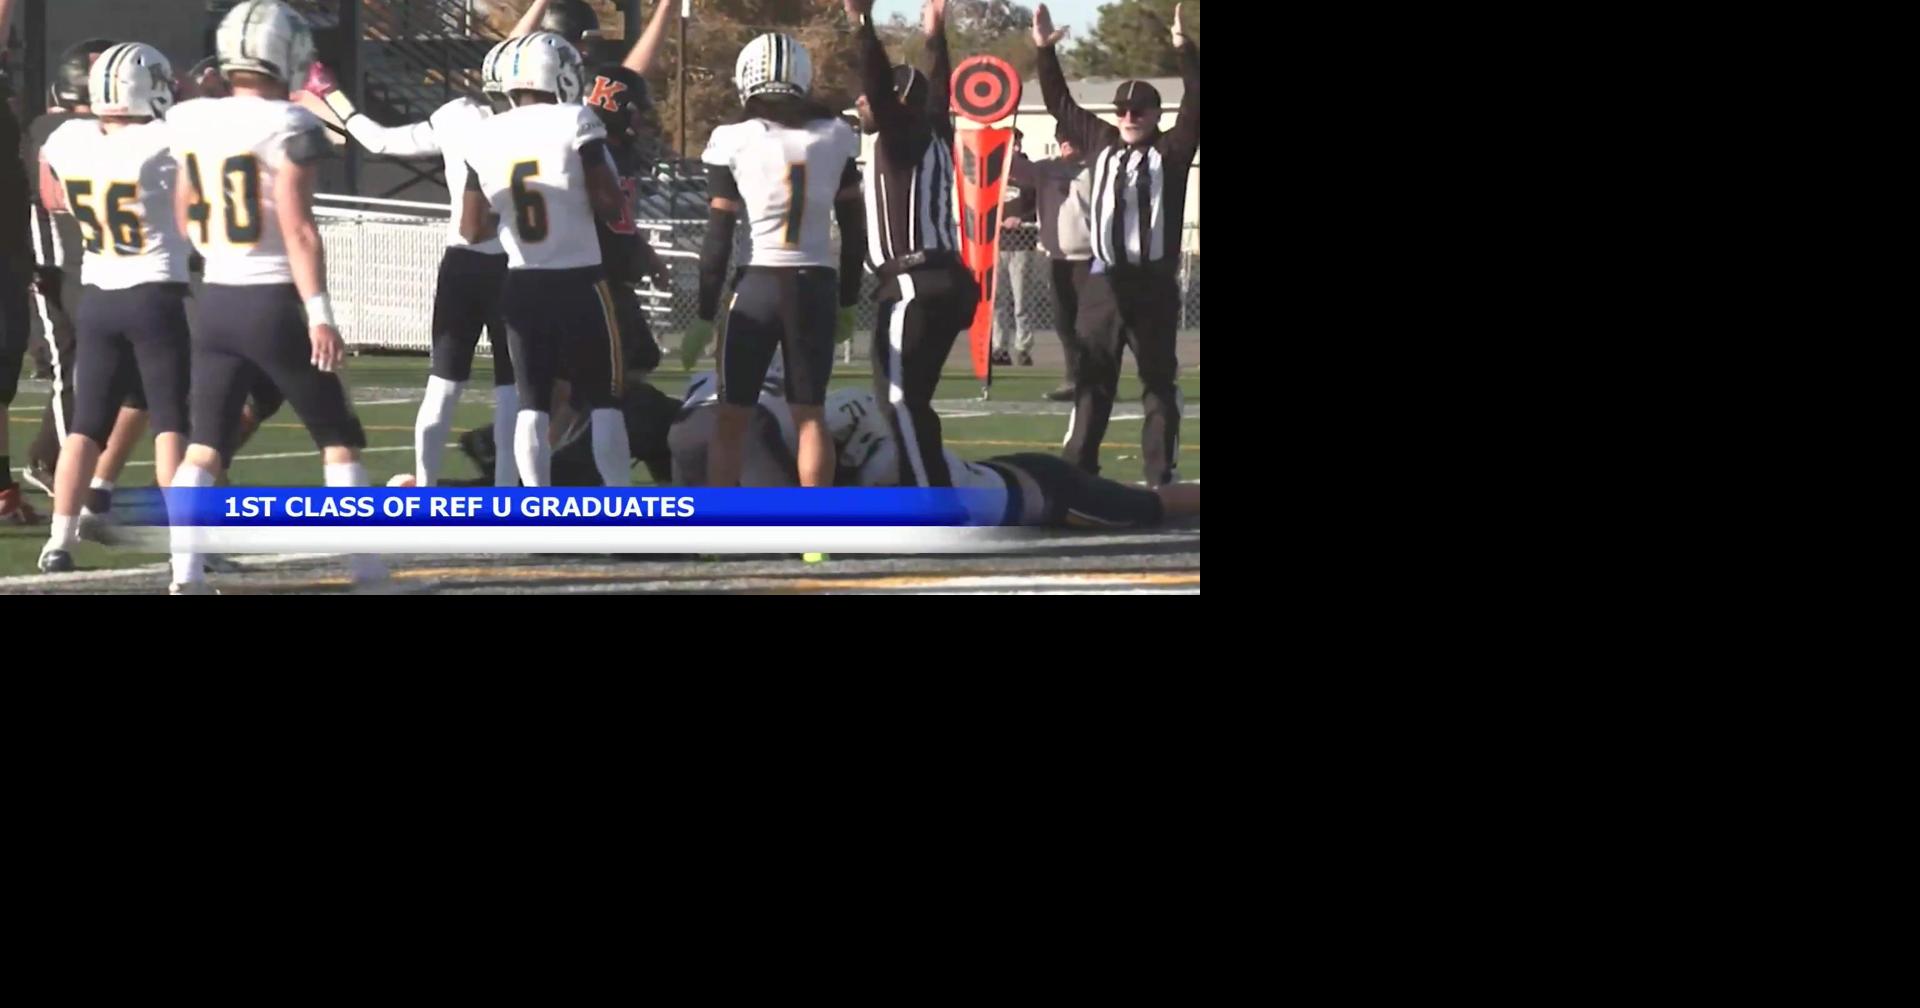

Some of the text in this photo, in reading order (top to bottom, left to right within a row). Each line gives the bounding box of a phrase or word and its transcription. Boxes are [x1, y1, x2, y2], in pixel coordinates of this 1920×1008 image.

[586, 75, 627, 112] K
[64, 177, 145, 257] 56
[512, 158, 549, 244] 6
[780, 161, 808, 250] 1
